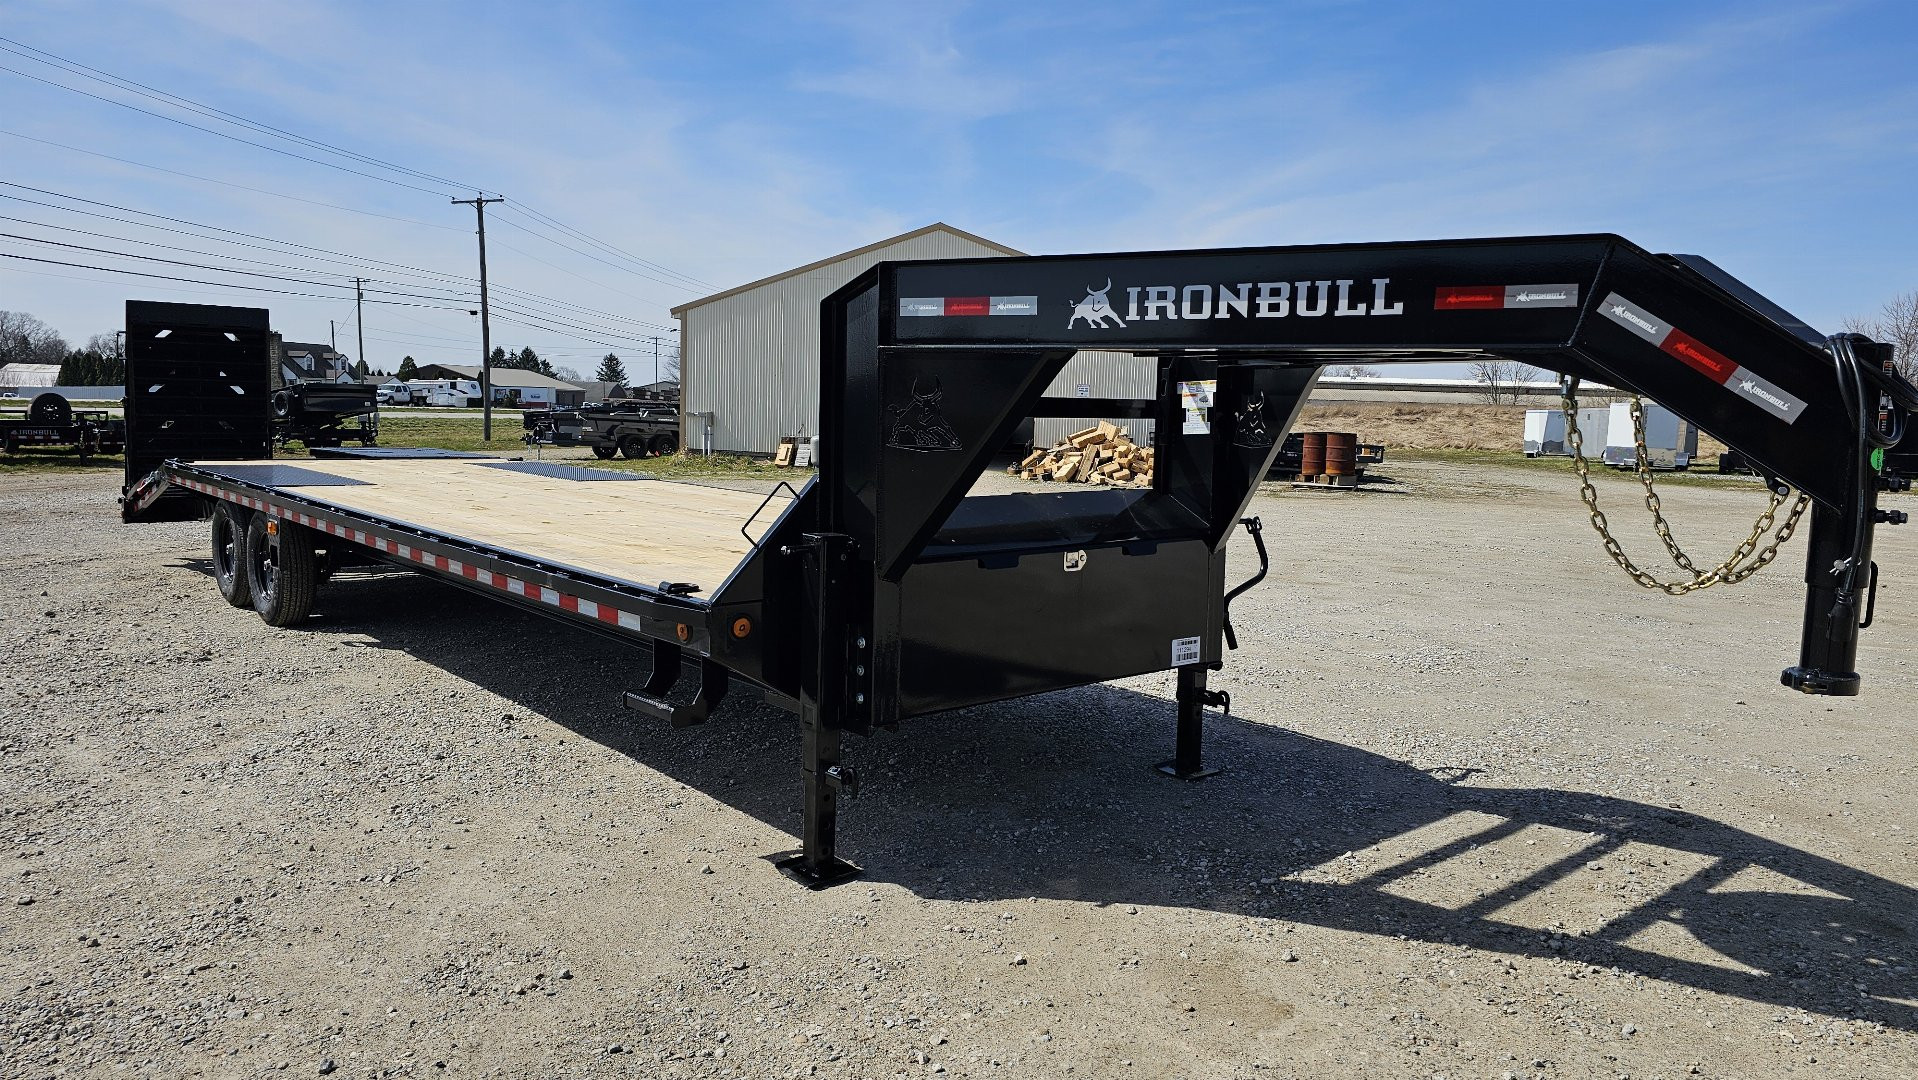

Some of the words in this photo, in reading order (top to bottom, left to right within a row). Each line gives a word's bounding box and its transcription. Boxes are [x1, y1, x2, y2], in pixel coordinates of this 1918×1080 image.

[1125, 277, 1403, 321] IRONBULL
[1623, 310, 1658, 334] IRONBULL
[1686, 347, 1722, 372] IRONBULL
[1752, 386, 1790, 411] IRONBULL
